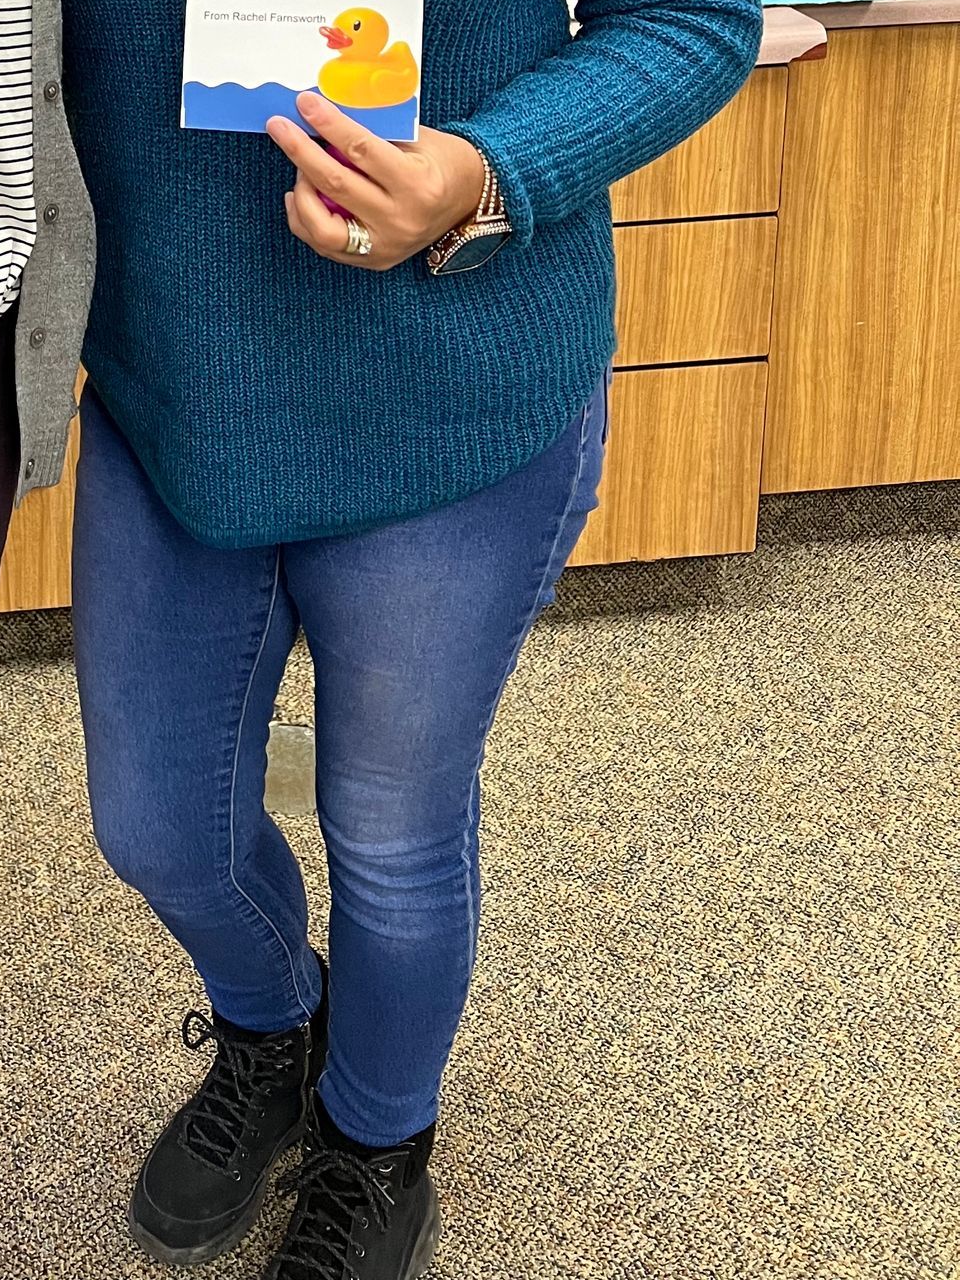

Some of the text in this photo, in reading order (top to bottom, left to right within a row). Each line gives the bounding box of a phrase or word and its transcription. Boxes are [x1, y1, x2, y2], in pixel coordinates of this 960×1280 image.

[204, 10, 327, 24] From Rachel Farnsworth
